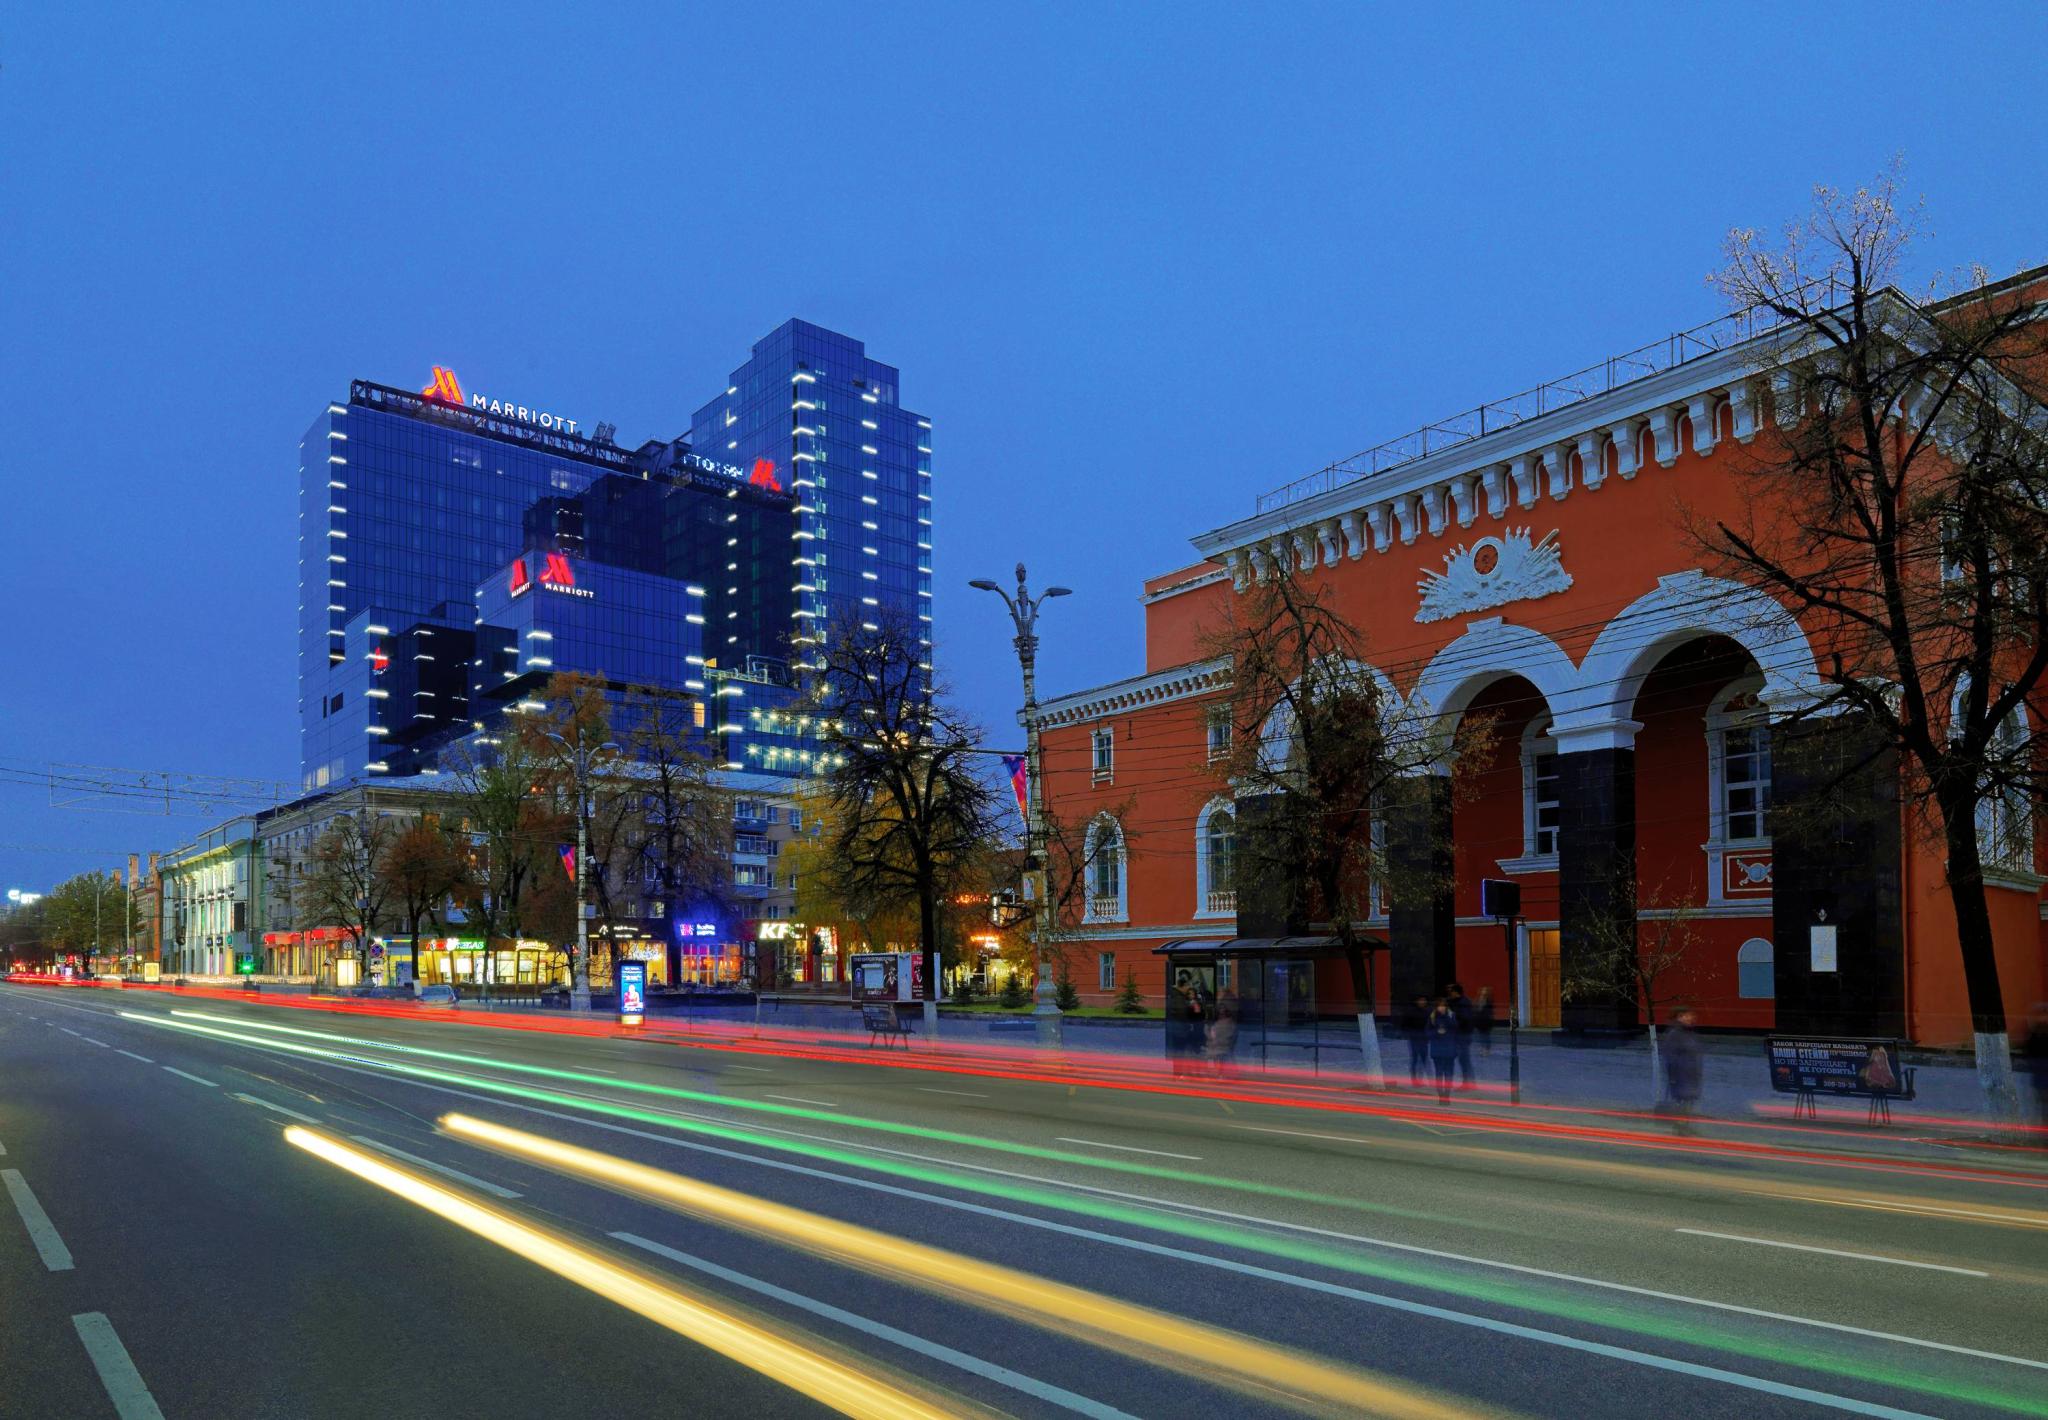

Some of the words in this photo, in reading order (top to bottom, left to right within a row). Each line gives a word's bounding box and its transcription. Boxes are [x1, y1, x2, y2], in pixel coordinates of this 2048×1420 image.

[472, 393, 577, 434] MARRIOTT
[545, 583, 594, 598] MARRIOTT
[759, 923, 804, 939] KFC
[1772, 1048, 1797, 1058] НАШИ
[1798, 1048, 1829, 1060] СТЕЙКИ
